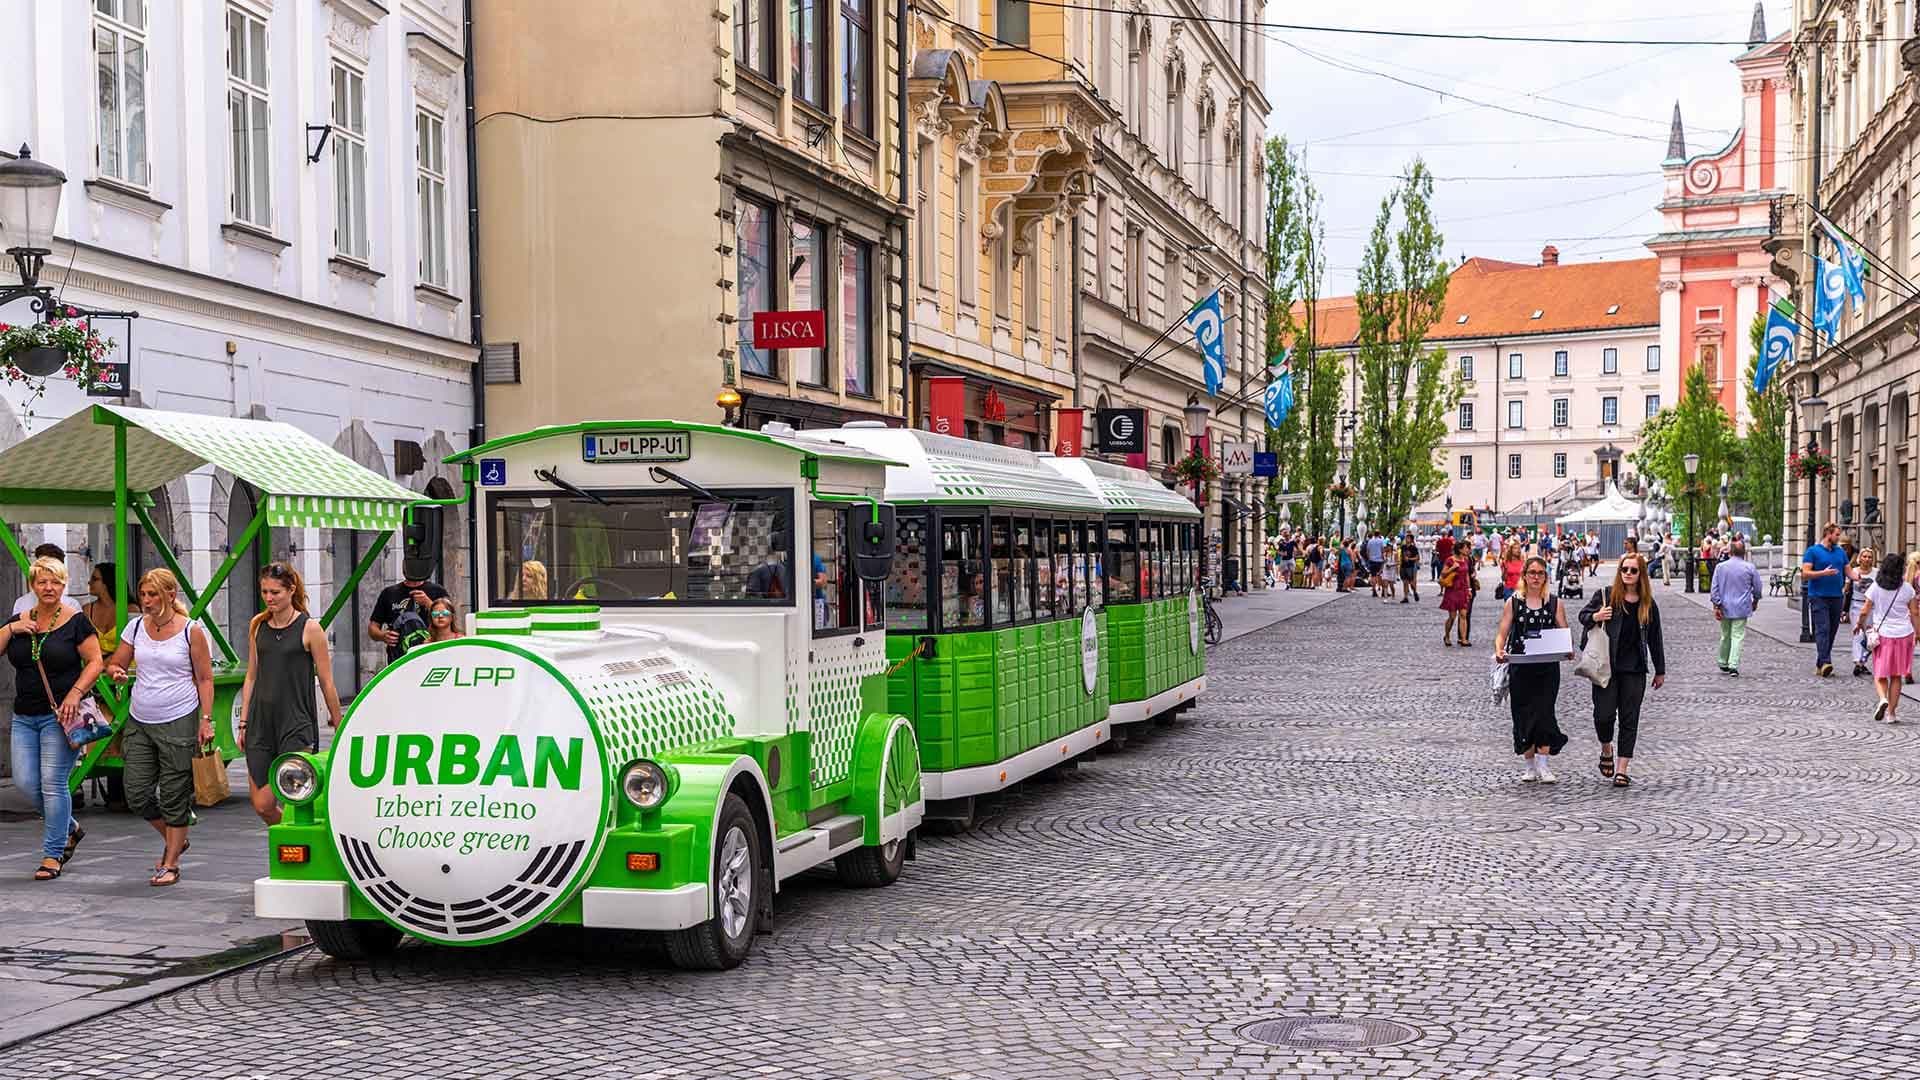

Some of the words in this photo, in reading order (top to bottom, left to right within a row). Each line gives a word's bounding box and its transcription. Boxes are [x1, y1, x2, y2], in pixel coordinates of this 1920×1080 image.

[761, 321, 815, 339] LISCA
[600, 438, 618, 455] LJ
[630, 437, 683, 454] LPP-U1
[454, 667, 515, 687] LPP
[348, 733, 584, 791] URBAN
[375, 794, 442, 818] Izberi
[450, 794, 537, 820] zeleno
[377, 825, 456, 849] Choose
[459, 831, 531, 855] green
